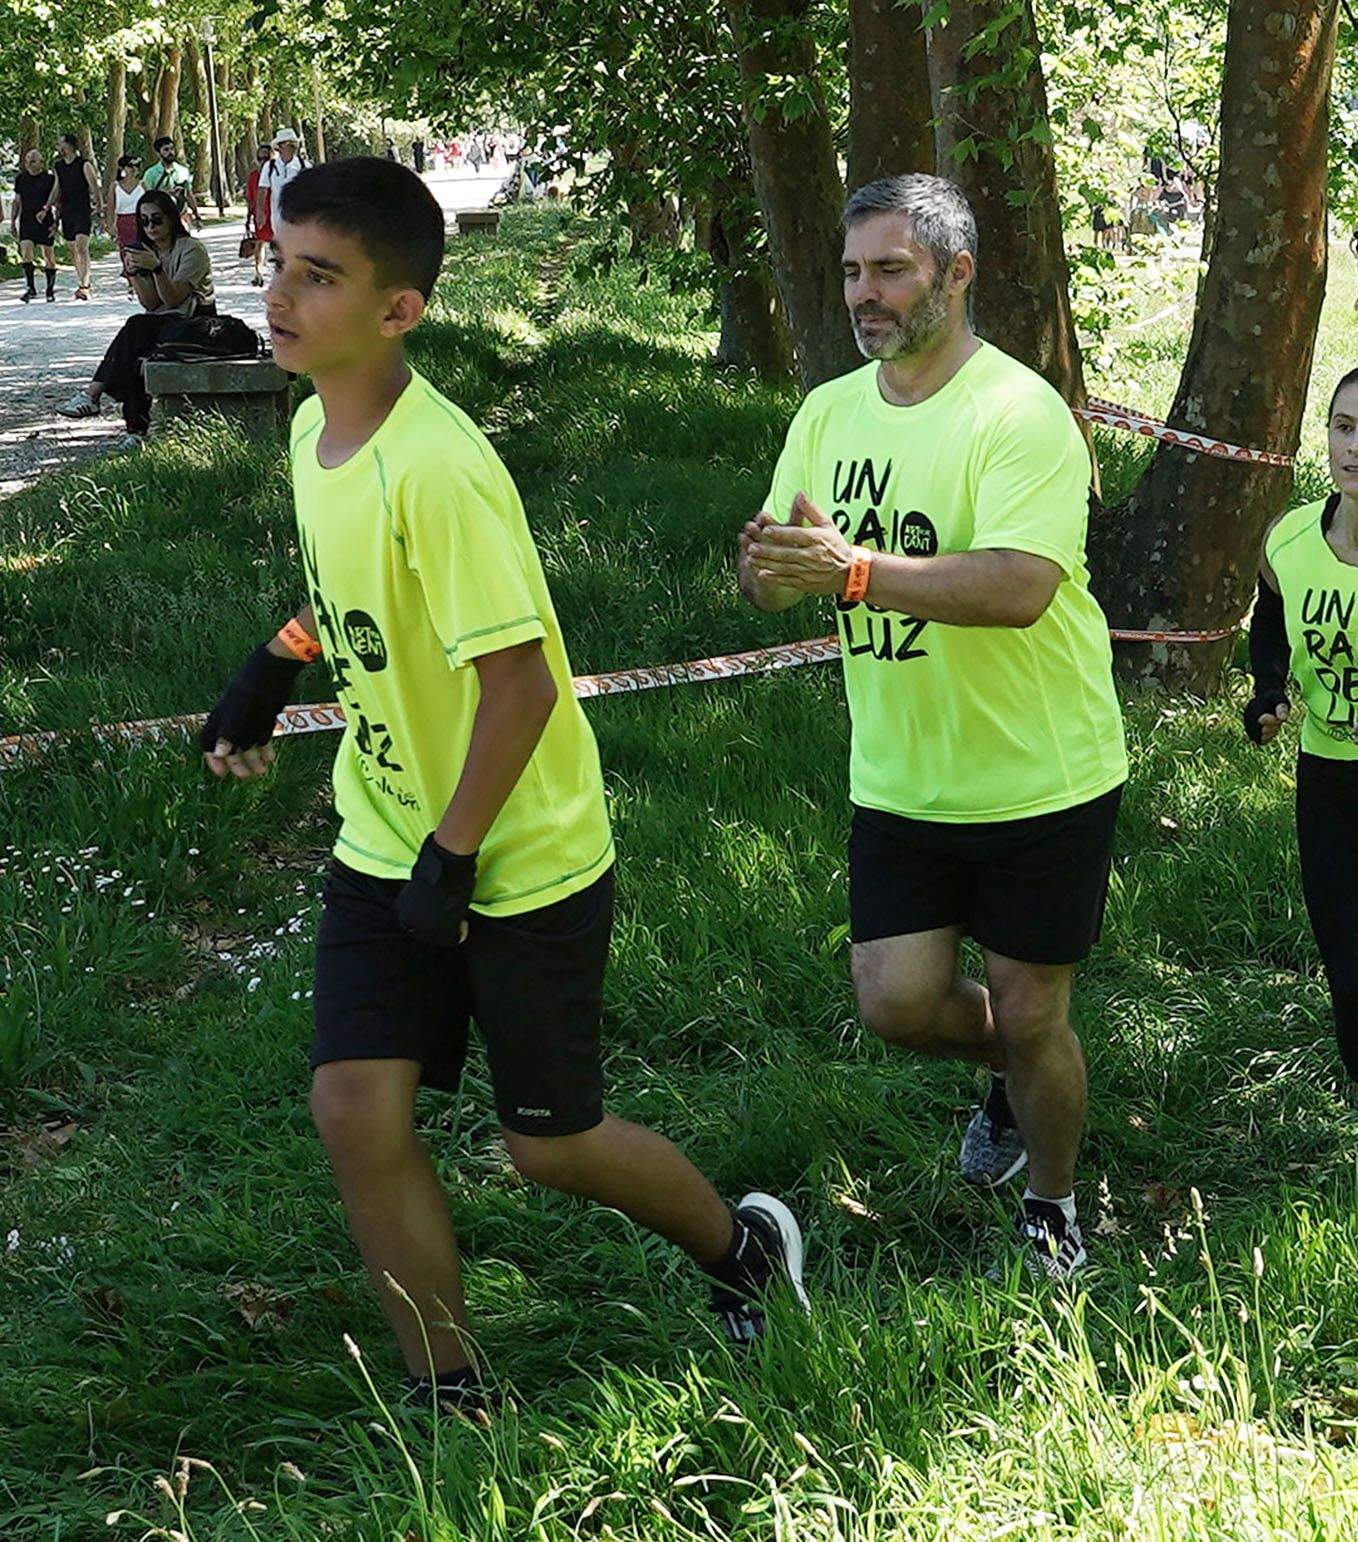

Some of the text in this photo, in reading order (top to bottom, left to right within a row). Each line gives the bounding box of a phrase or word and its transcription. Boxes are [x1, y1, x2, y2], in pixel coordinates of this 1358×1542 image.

[832, 457, 893, 507] UN
[1301, 587, 1356, 630] UN
[842, 612, 929, 662] LUZ
